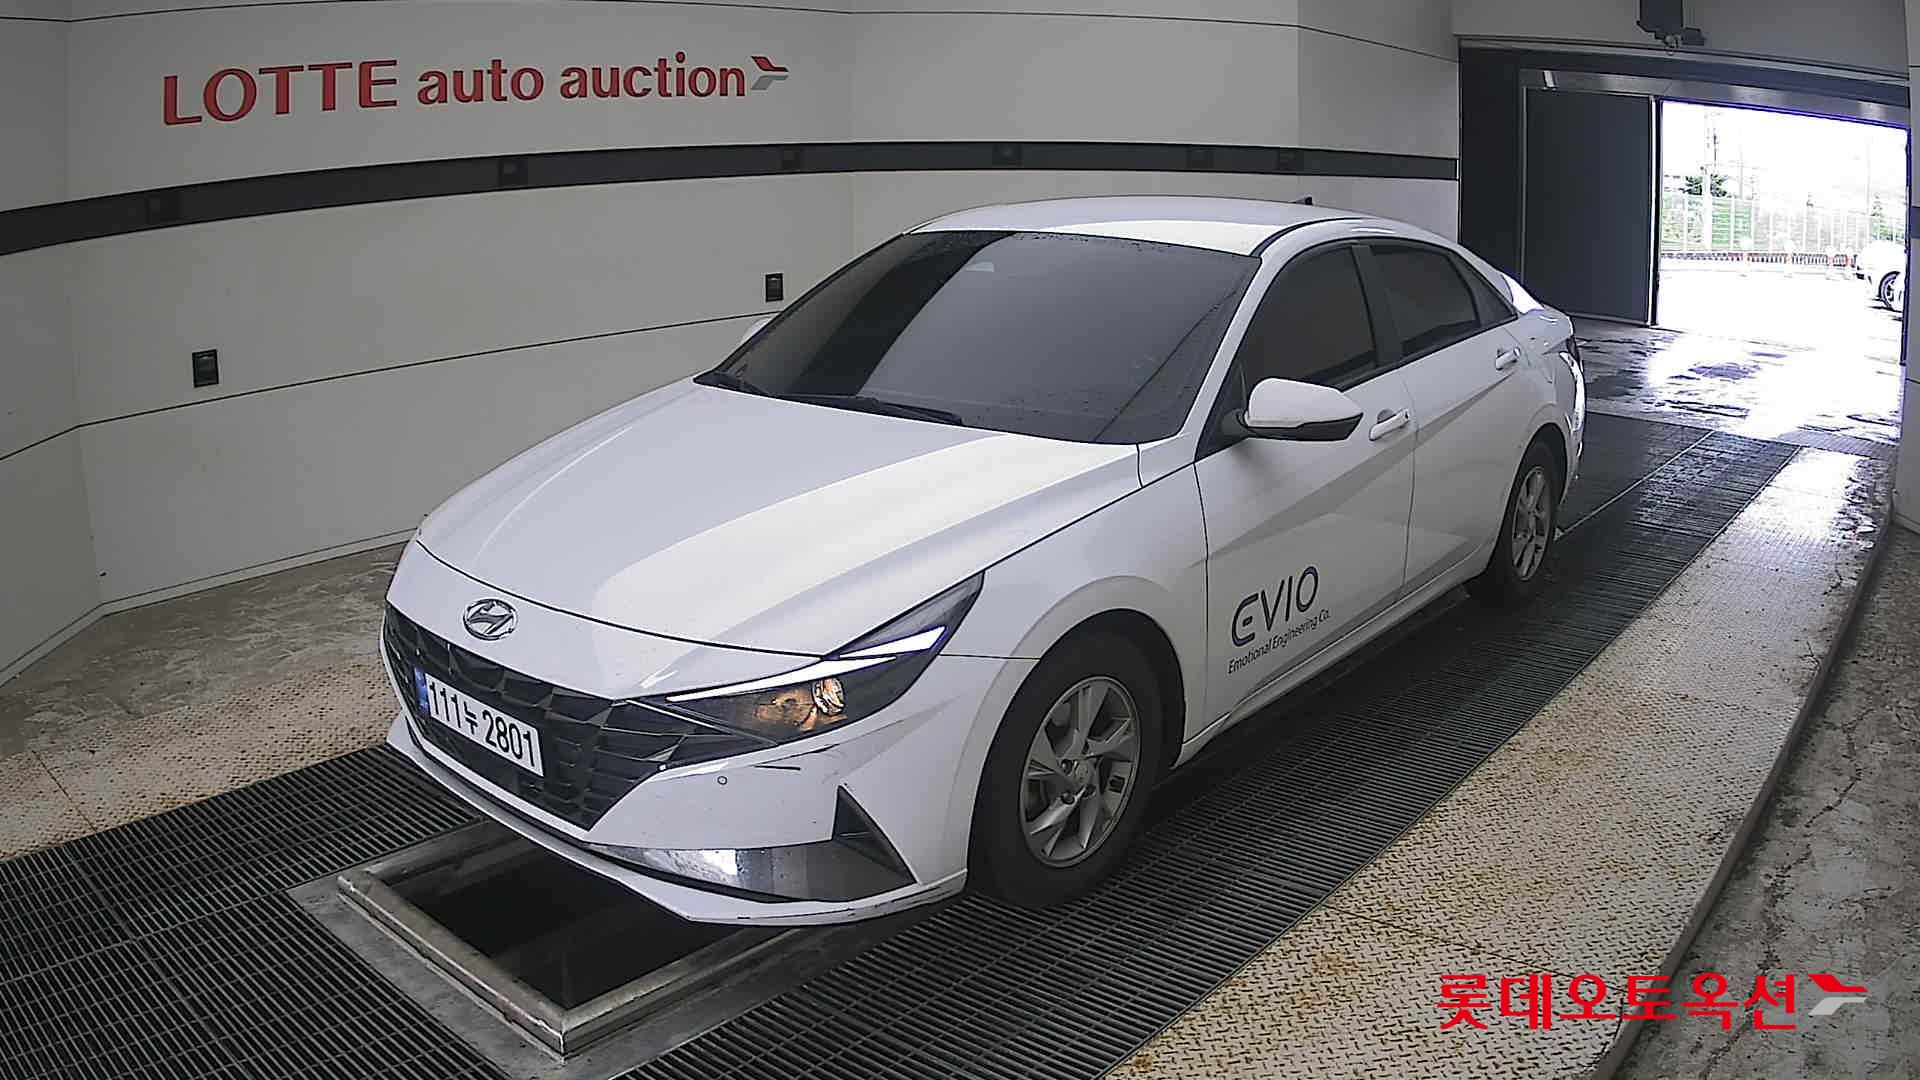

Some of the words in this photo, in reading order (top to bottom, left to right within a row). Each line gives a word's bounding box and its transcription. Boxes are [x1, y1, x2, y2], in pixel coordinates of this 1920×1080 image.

[163, 59, 399, 126] LOTTE
[416, 58, 545, 105] auto
[559, 51, 747, 99] auction
[1231, 565, 1319, 648] EVIO
[1227, 638, 1272, 675] Emotional
[1271, 616, 1317, 649] Engineering
[481, 709, 536, 768] 2801
